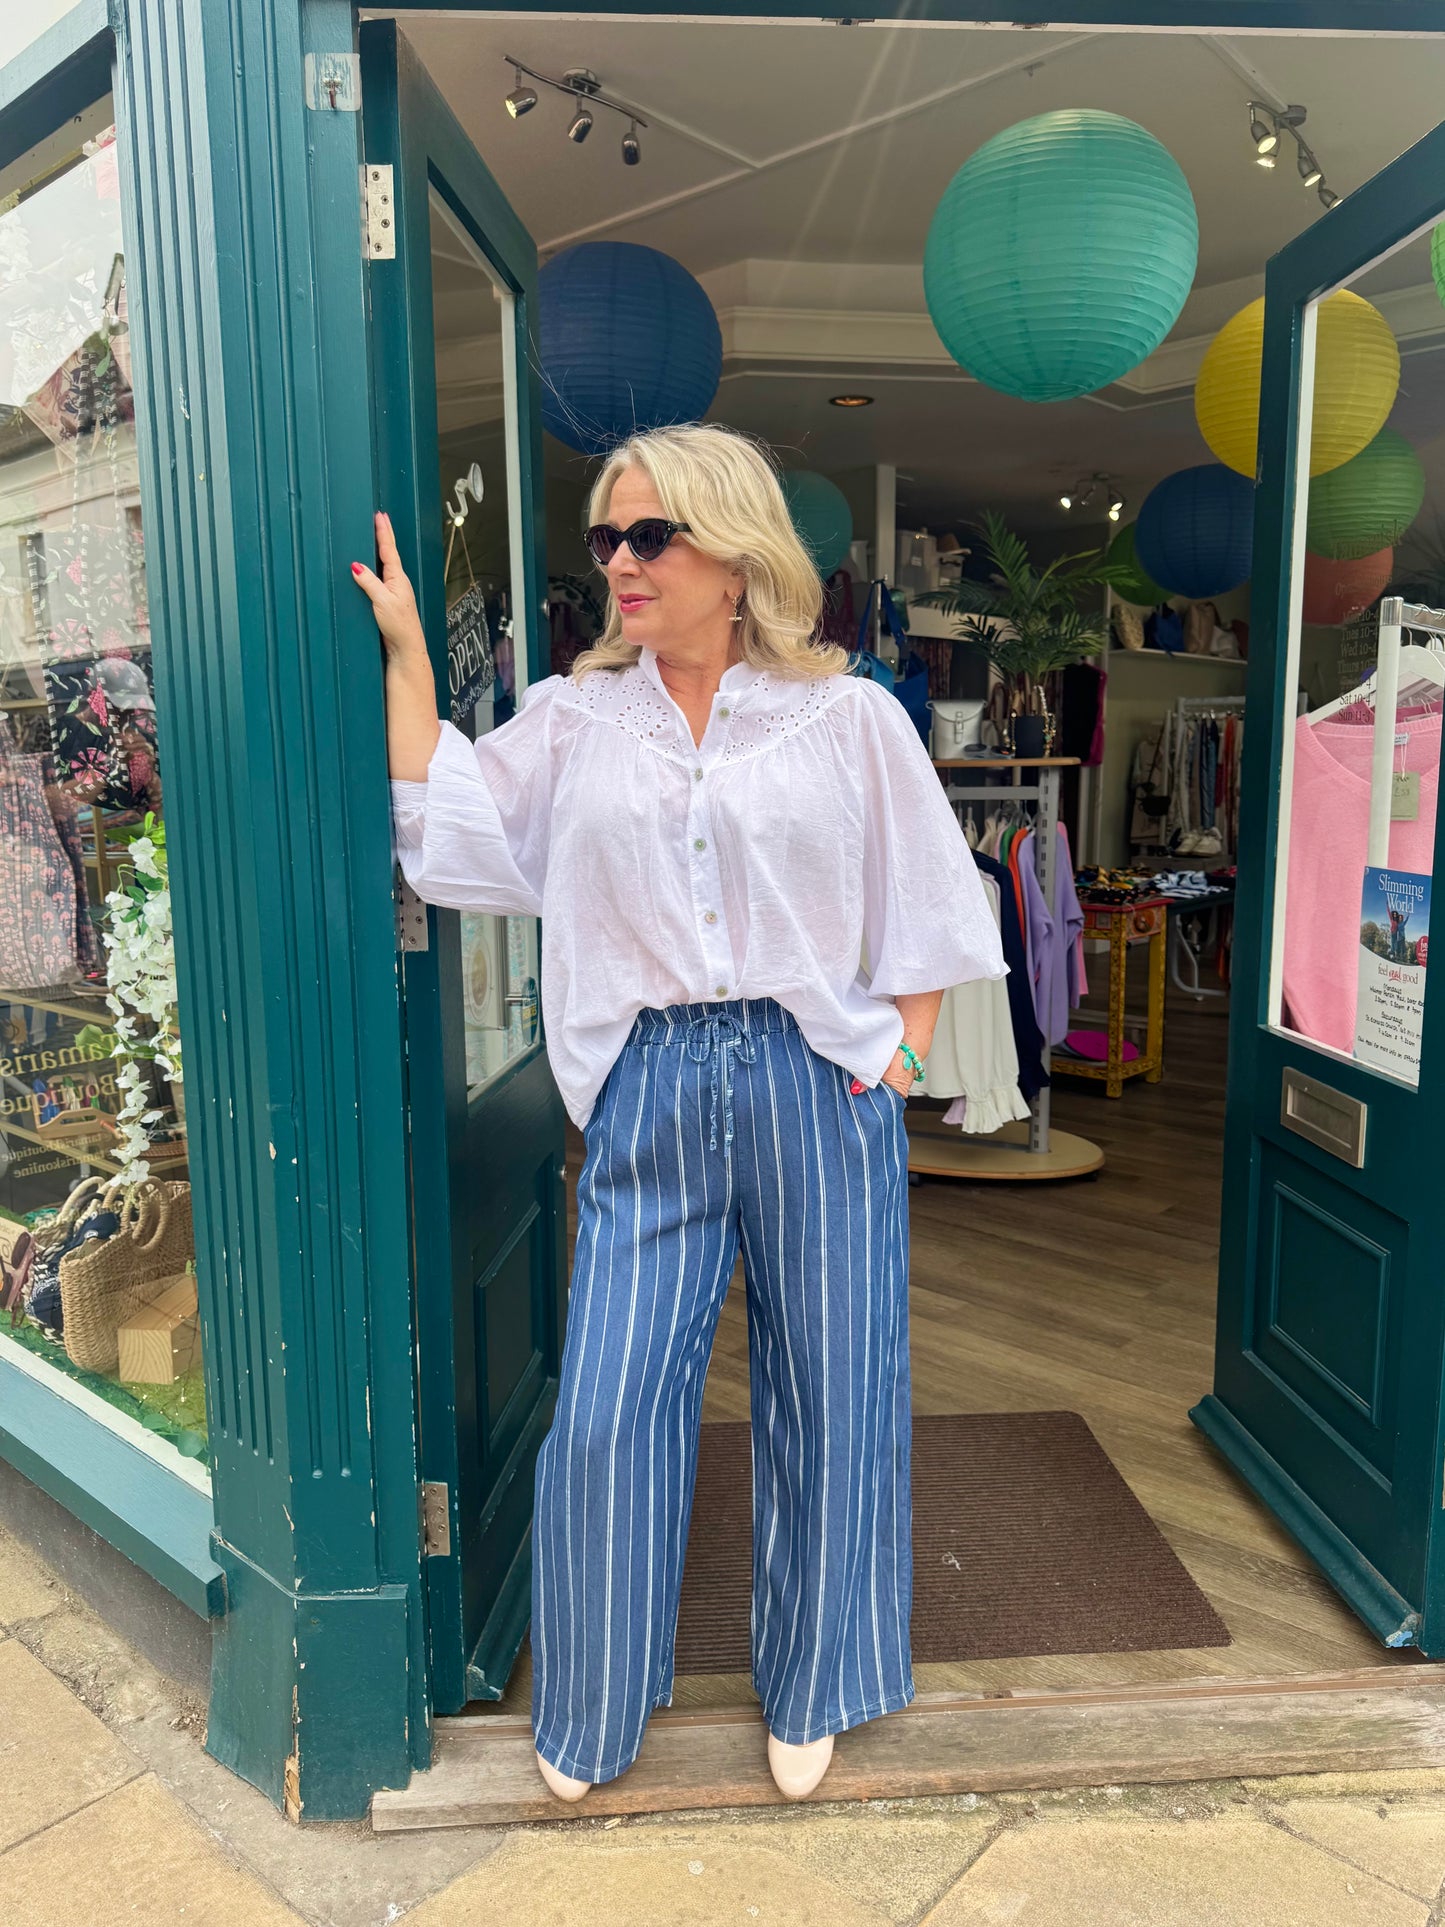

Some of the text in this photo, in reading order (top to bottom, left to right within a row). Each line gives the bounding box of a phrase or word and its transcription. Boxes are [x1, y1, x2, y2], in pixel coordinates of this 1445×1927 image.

[1360, 625, 1378, 639] 10-4
[1341, 641, 1377, 656] Wed 10-4
[447, 622, 486, 695] OPEN
[1339, 693, 1371, 708] Sat 10-4
[1338, 708, 1352, 721] Sun
[1378, 873, 1424, 901] Slimming
[1387, 892, 1414, 914] World
[1378, 963, 1389, 976] feel
[1402, 972, 1418, 985] good
